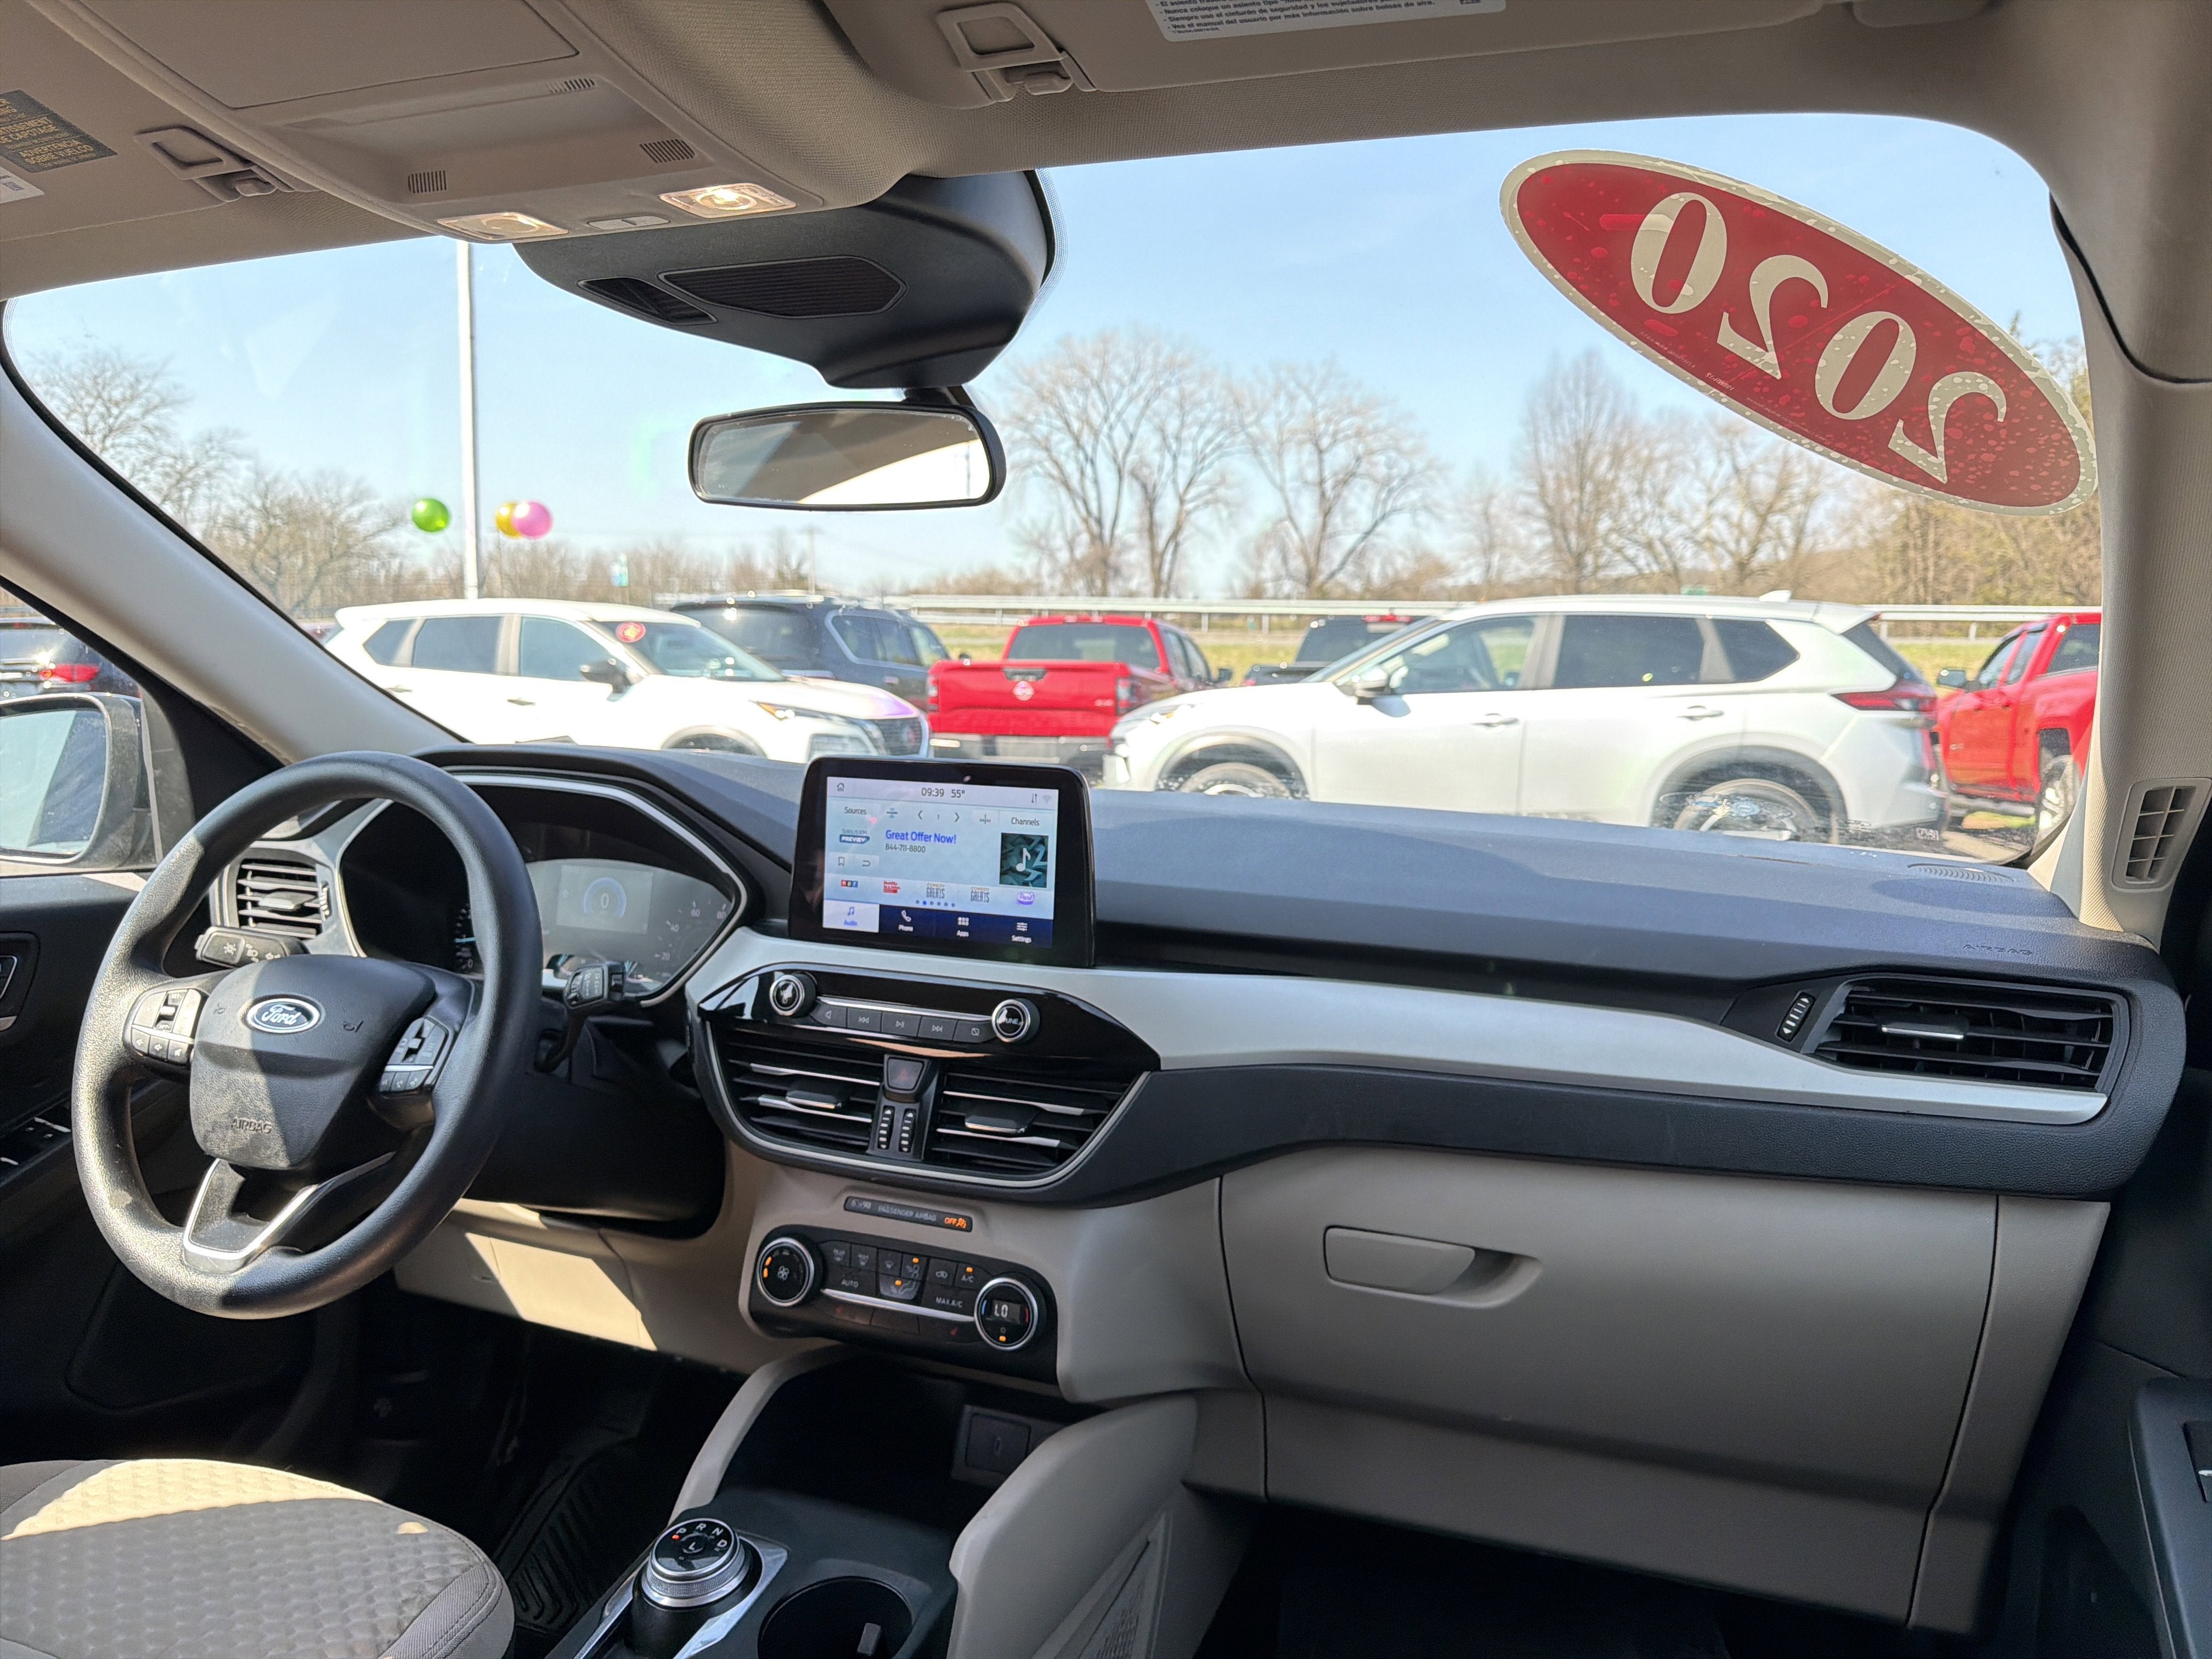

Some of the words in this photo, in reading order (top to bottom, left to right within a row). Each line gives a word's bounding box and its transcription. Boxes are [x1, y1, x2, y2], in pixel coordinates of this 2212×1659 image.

[1270, 4, 1308, 13] seguridad
[1302, 8, 1350, 18] información
[0, 116, 54, 136] TISSEMENT
[19, 139, 81, 157] ADVERTENCIA
[921, 787, 945, 797] 09:39
[951, 789, 966, 798] 55°
[844, 806, 867, 815] Sources
[1011, 817, 1040, 826] Channels
[885, 829, 909, 840] Great
[911, 831, 932, 843] Offer
[934, 833, 957, 844] Now!
[885, 843, 926, 853] 844-711-8800
[1011, 935, 1032, 944] Settings
[261, 1003, 302, 1025] Ford
[231, 1116, 273, 1135] AIRBAG
[878, 1205, 913, 1218] PASSENGER
[913, 1211, 937, 1222] AIRBAG
[943, 1216, 957, 1225] OFF
[961, 1274, 974, 1283] A/C
[841, 1279, 859, 1288] AUTO
[935, 1296, 950, 1305] MAX
[994, 1304, 1009, 1318] LO
[695, 1522, 707, 1531] R
[711, 1527, 724, 1536] N
[689, 1541, 696, 1550] L
[716, 1539, 727, 1548] D
